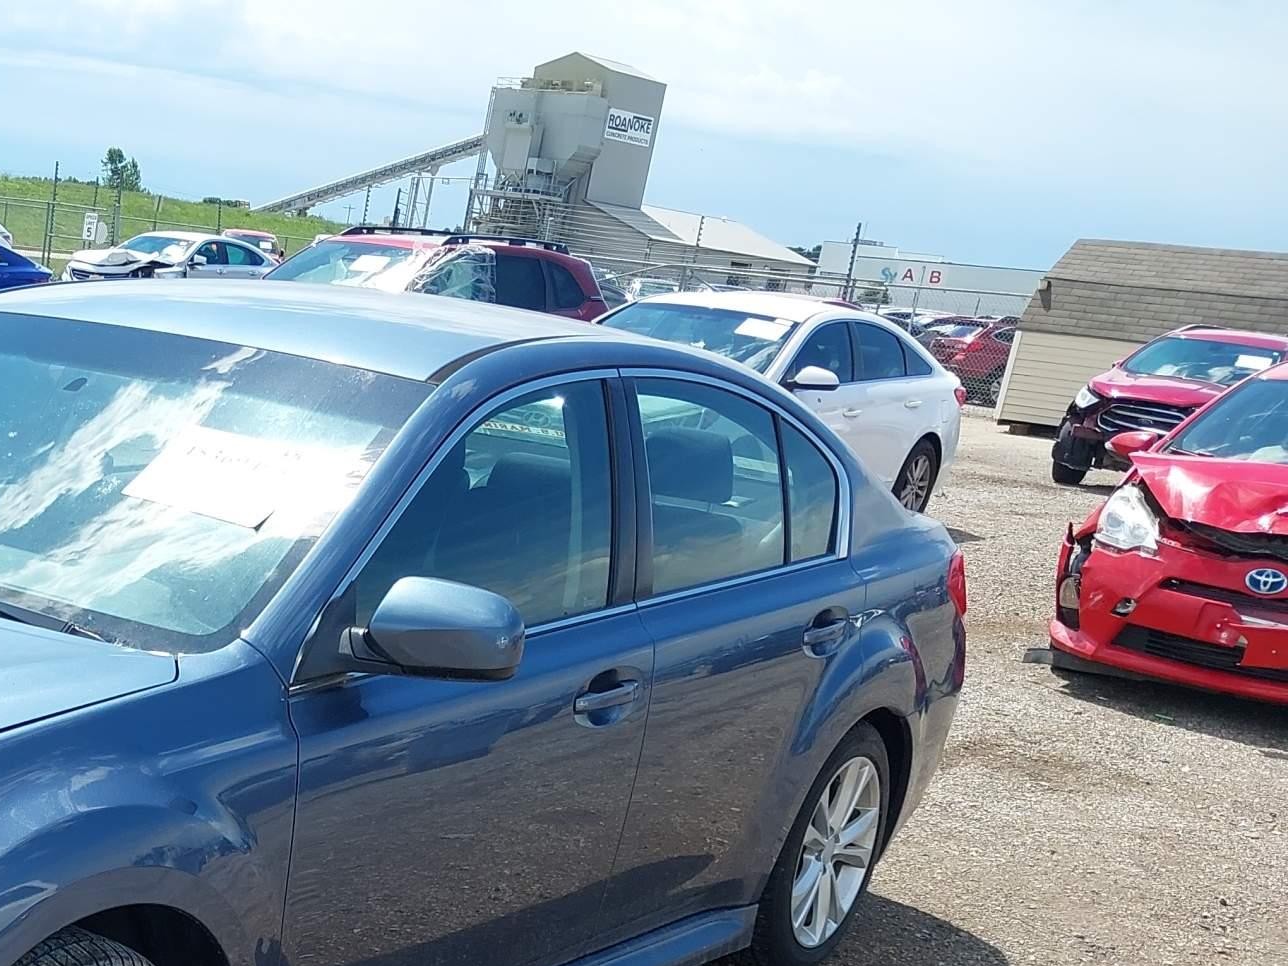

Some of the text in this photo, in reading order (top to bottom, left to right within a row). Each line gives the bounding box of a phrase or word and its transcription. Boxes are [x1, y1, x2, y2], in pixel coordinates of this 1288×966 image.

[608, 114, 652, 134] ROANOKE
[86, 227, 92, 238] 5
[901, 267, 942, 284] A B
